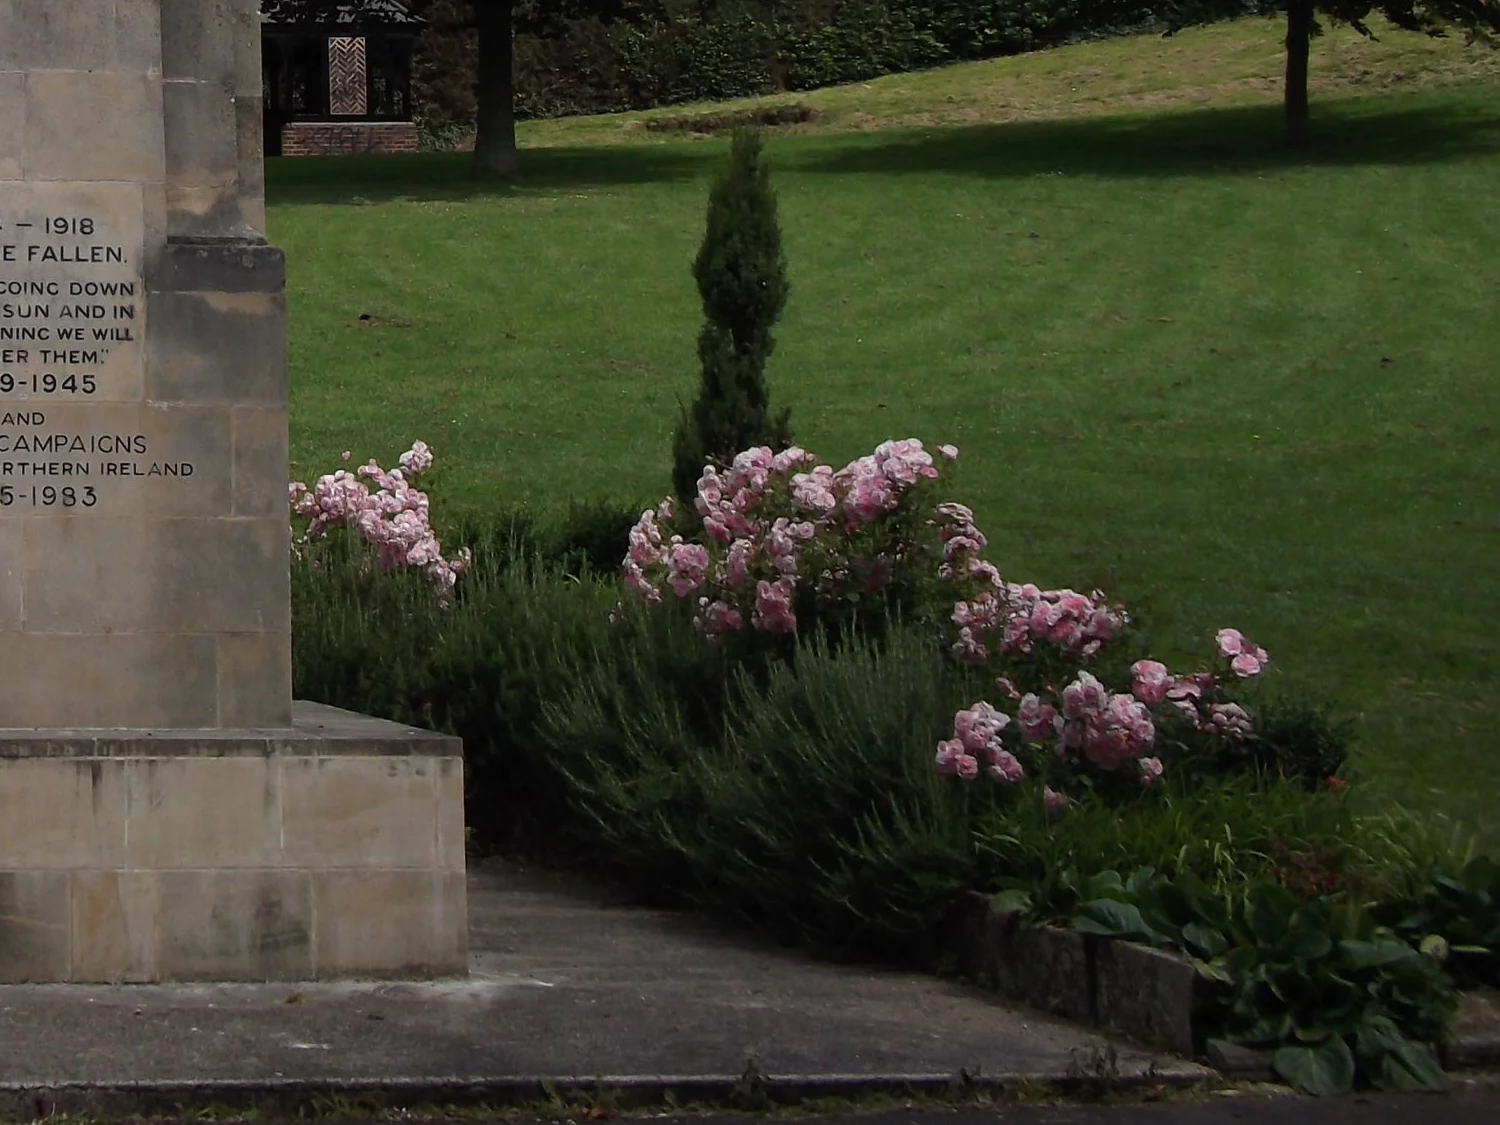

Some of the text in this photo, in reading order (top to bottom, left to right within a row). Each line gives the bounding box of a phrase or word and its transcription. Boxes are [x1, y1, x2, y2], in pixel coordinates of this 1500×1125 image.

[45, 216, 95, 236] 1918
[27, 244, 129, 264] FALLEN.
[68, 282, 135, 297] DOWN
[2, 303, 50, 319] SUN
[58, 304, 106, 319] AND
[112, 305, 135, 320] IN
[57, 327, 85, 342] WE
[91, 327, 135, 342] WILL
[0, 412, 45, 426] AND
[100, 462, 195, 477] IRELAND
